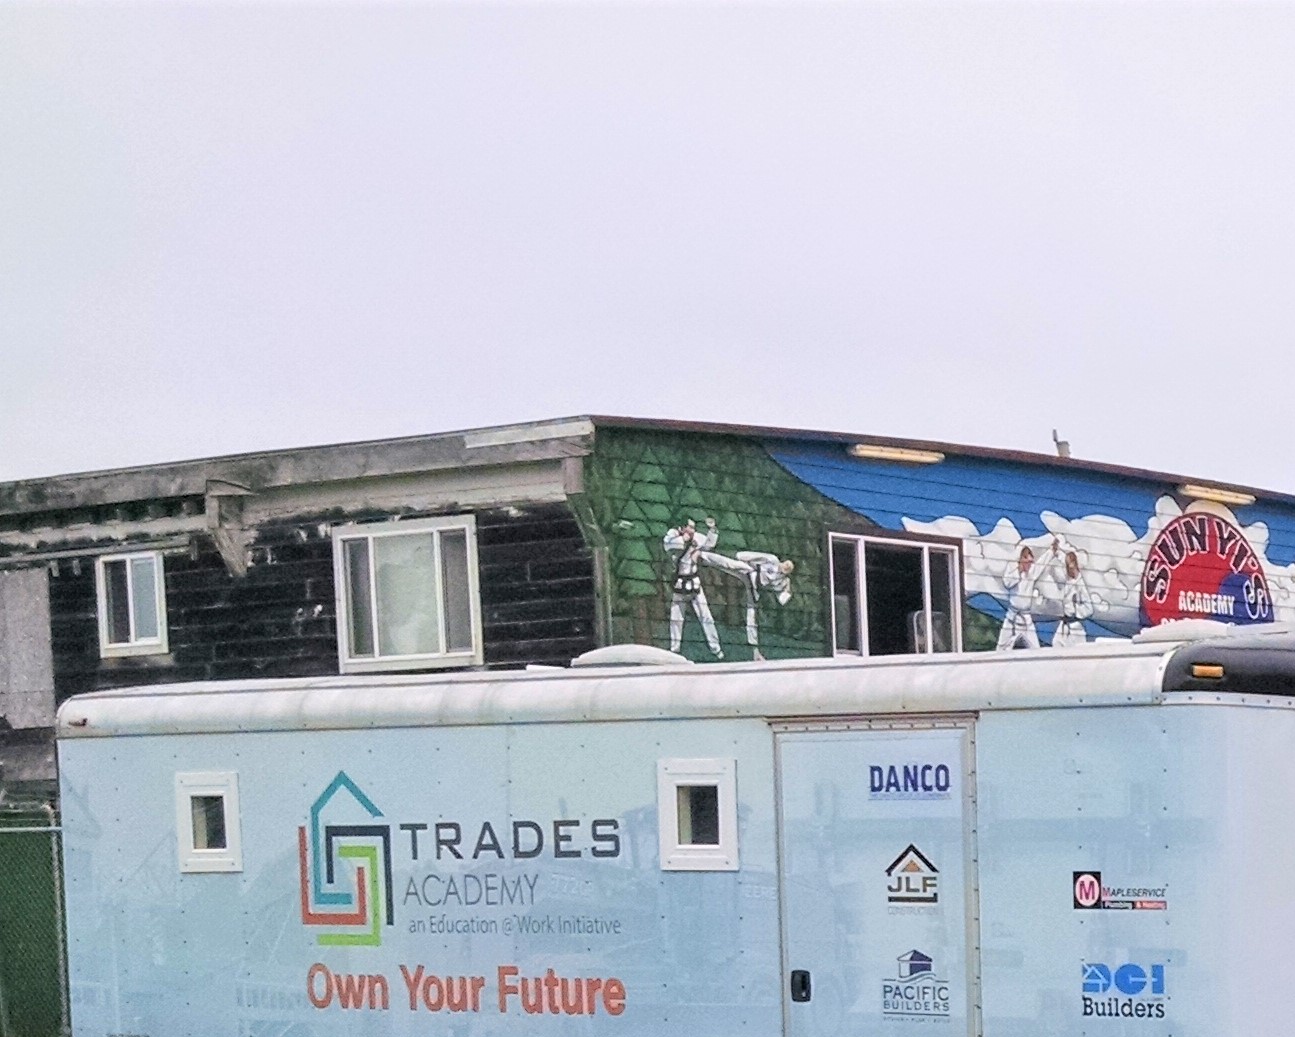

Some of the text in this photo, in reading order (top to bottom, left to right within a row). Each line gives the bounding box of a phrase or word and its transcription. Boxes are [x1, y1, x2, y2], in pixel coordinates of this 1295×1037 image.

[1144, 515, 1210, 604] SUN
[1178, 591, 1235, 615] ACADEMY
[869, 763, 950, 792] DANCO
[400, 819, 621, 861] TRADES
[403, 873, 539, 907] ACADEMY
[887, 876, 937, 893] JLF
[1079, 880, 1096, 900] M
[409, 914, 622, 936] an Education @ Work Initiative
[307, 962, 627, 1017] Own Your Future
[883, 985, 949, 1001] PACIFIC
[883, 1001, 950, 1012] BUILDERS
[1082, 995, 1165, 1018] Builders
